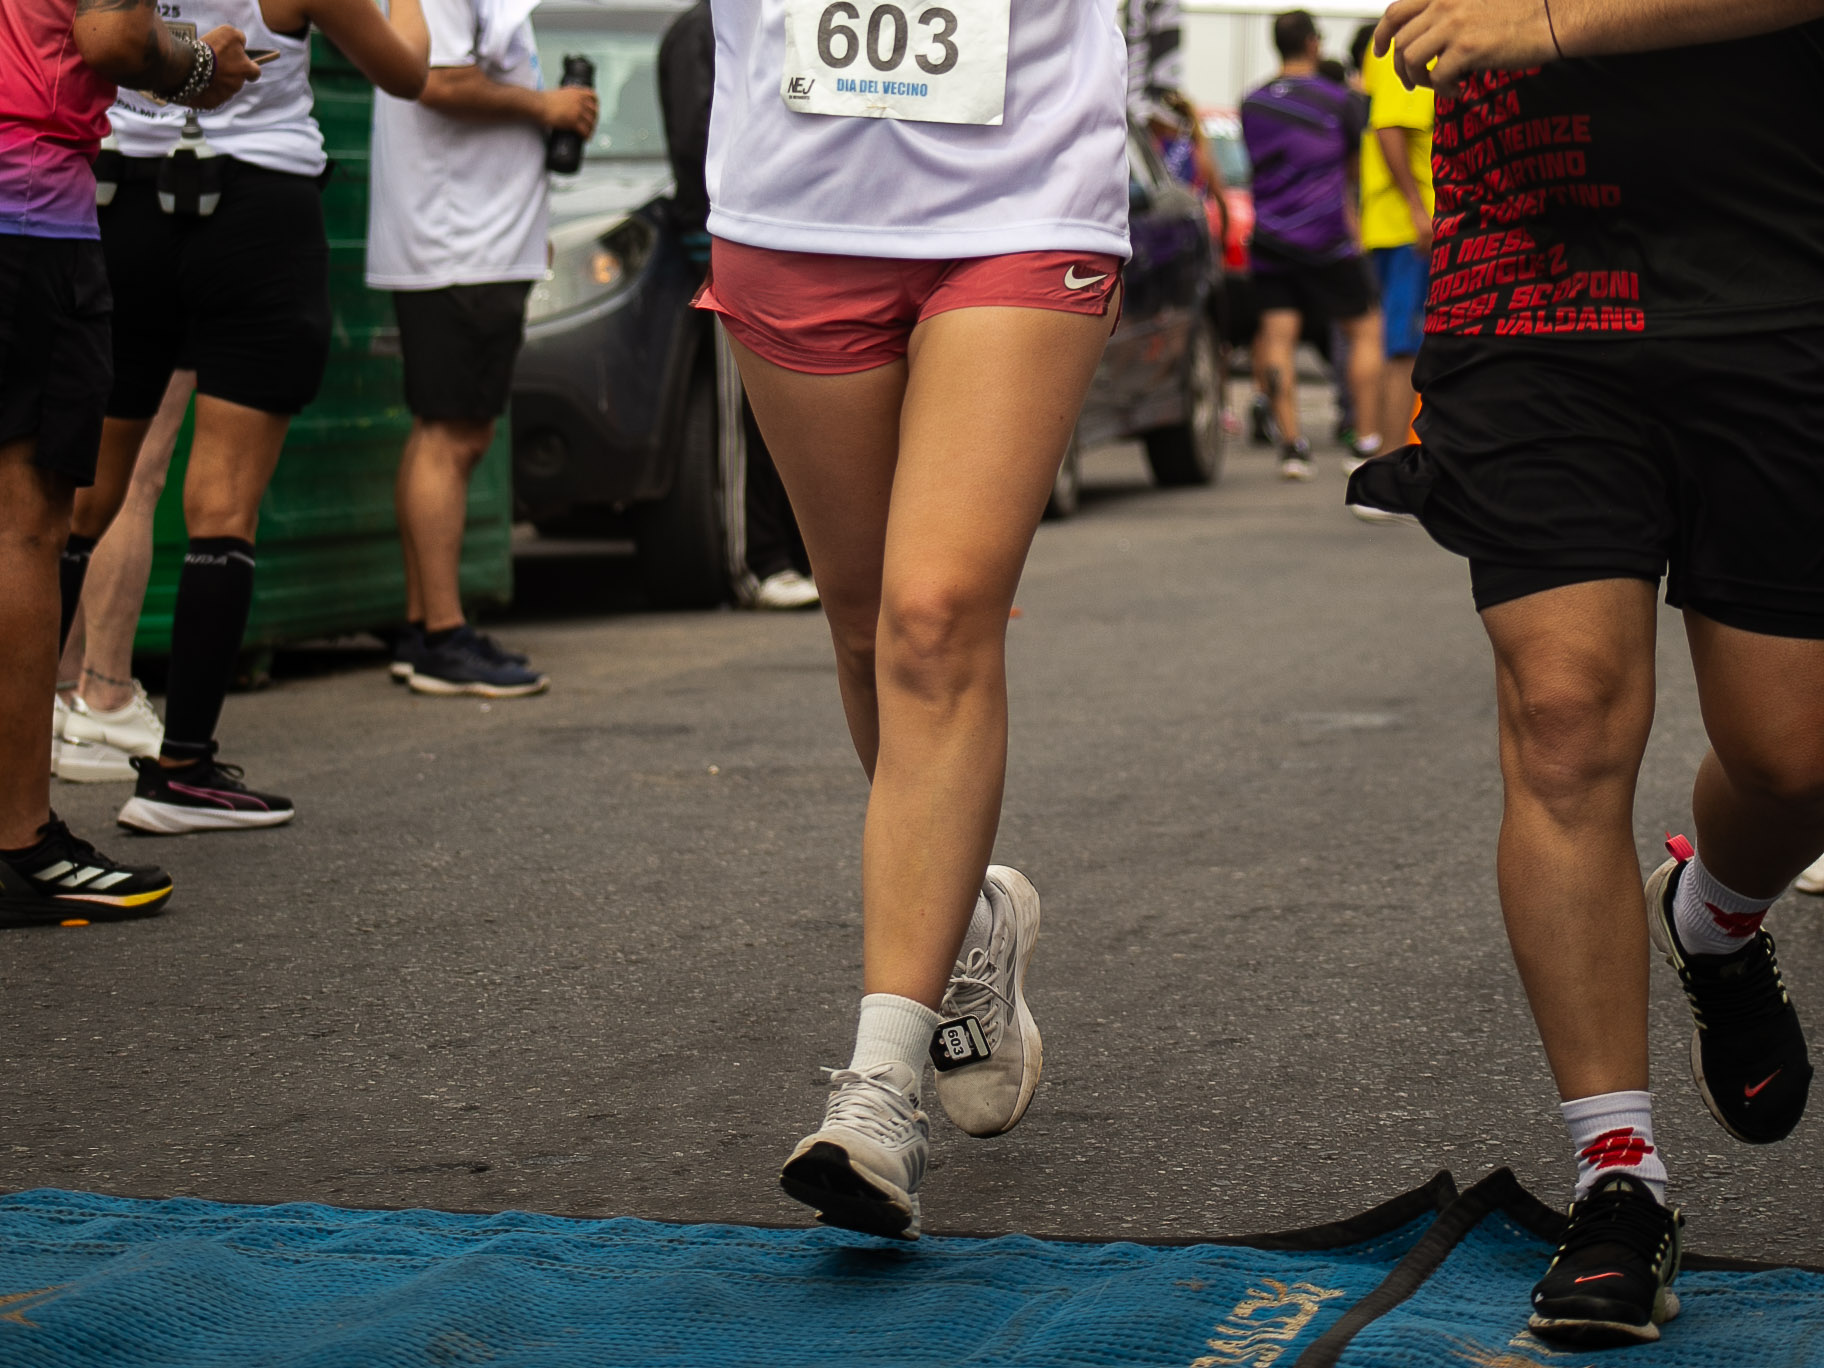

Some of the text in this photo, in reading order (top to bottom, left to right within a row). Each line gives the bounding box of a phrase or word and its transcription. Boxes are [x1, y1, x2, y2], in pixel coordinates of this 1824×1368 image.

[817, 1, 959, 76] 603
[836, 78, 929, 97] DIA DEL VECINO
[1495, 306, 1645, 336] VALDANO
[947, 1029, 964, 1056] 603
